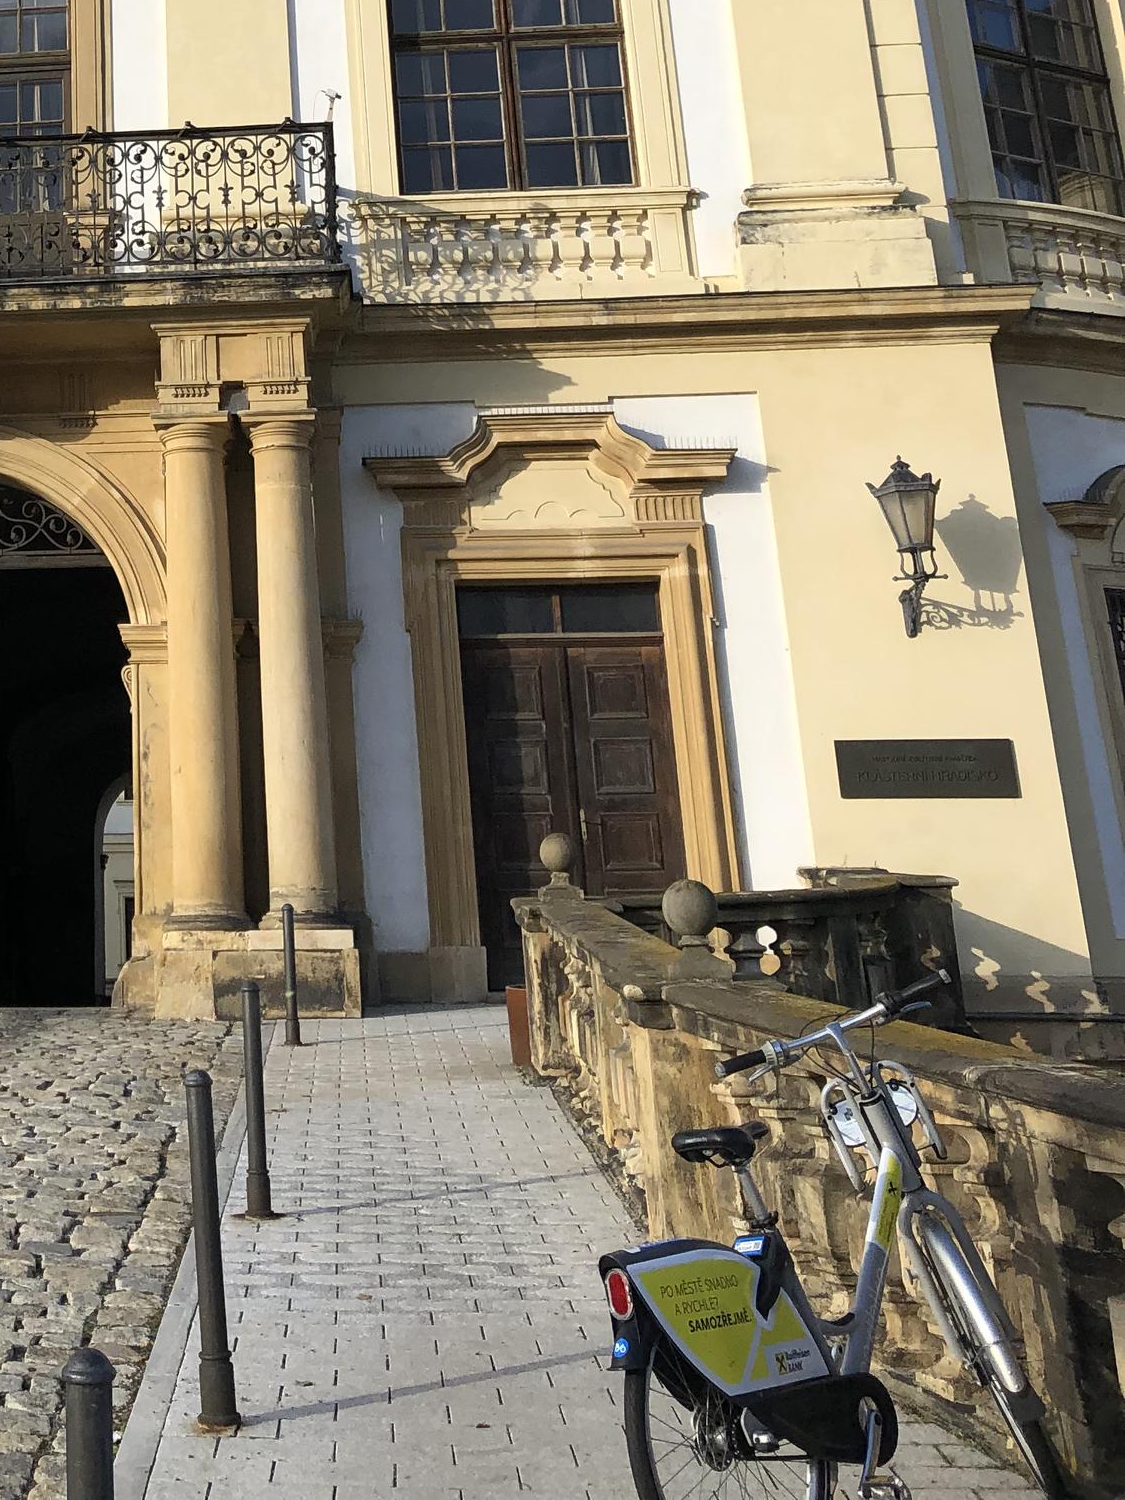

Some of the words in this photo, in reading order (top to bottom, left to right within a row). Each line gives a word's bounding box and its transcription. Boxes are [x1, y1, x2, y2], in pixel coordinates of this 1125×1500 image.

[659, 1285, 674, 1298] PO
[674, 1277, 704, 1296] MĚSTĚ
[704, 1274, 739, 1292] SNADNO
[675, 1303, 682, 1315] A
